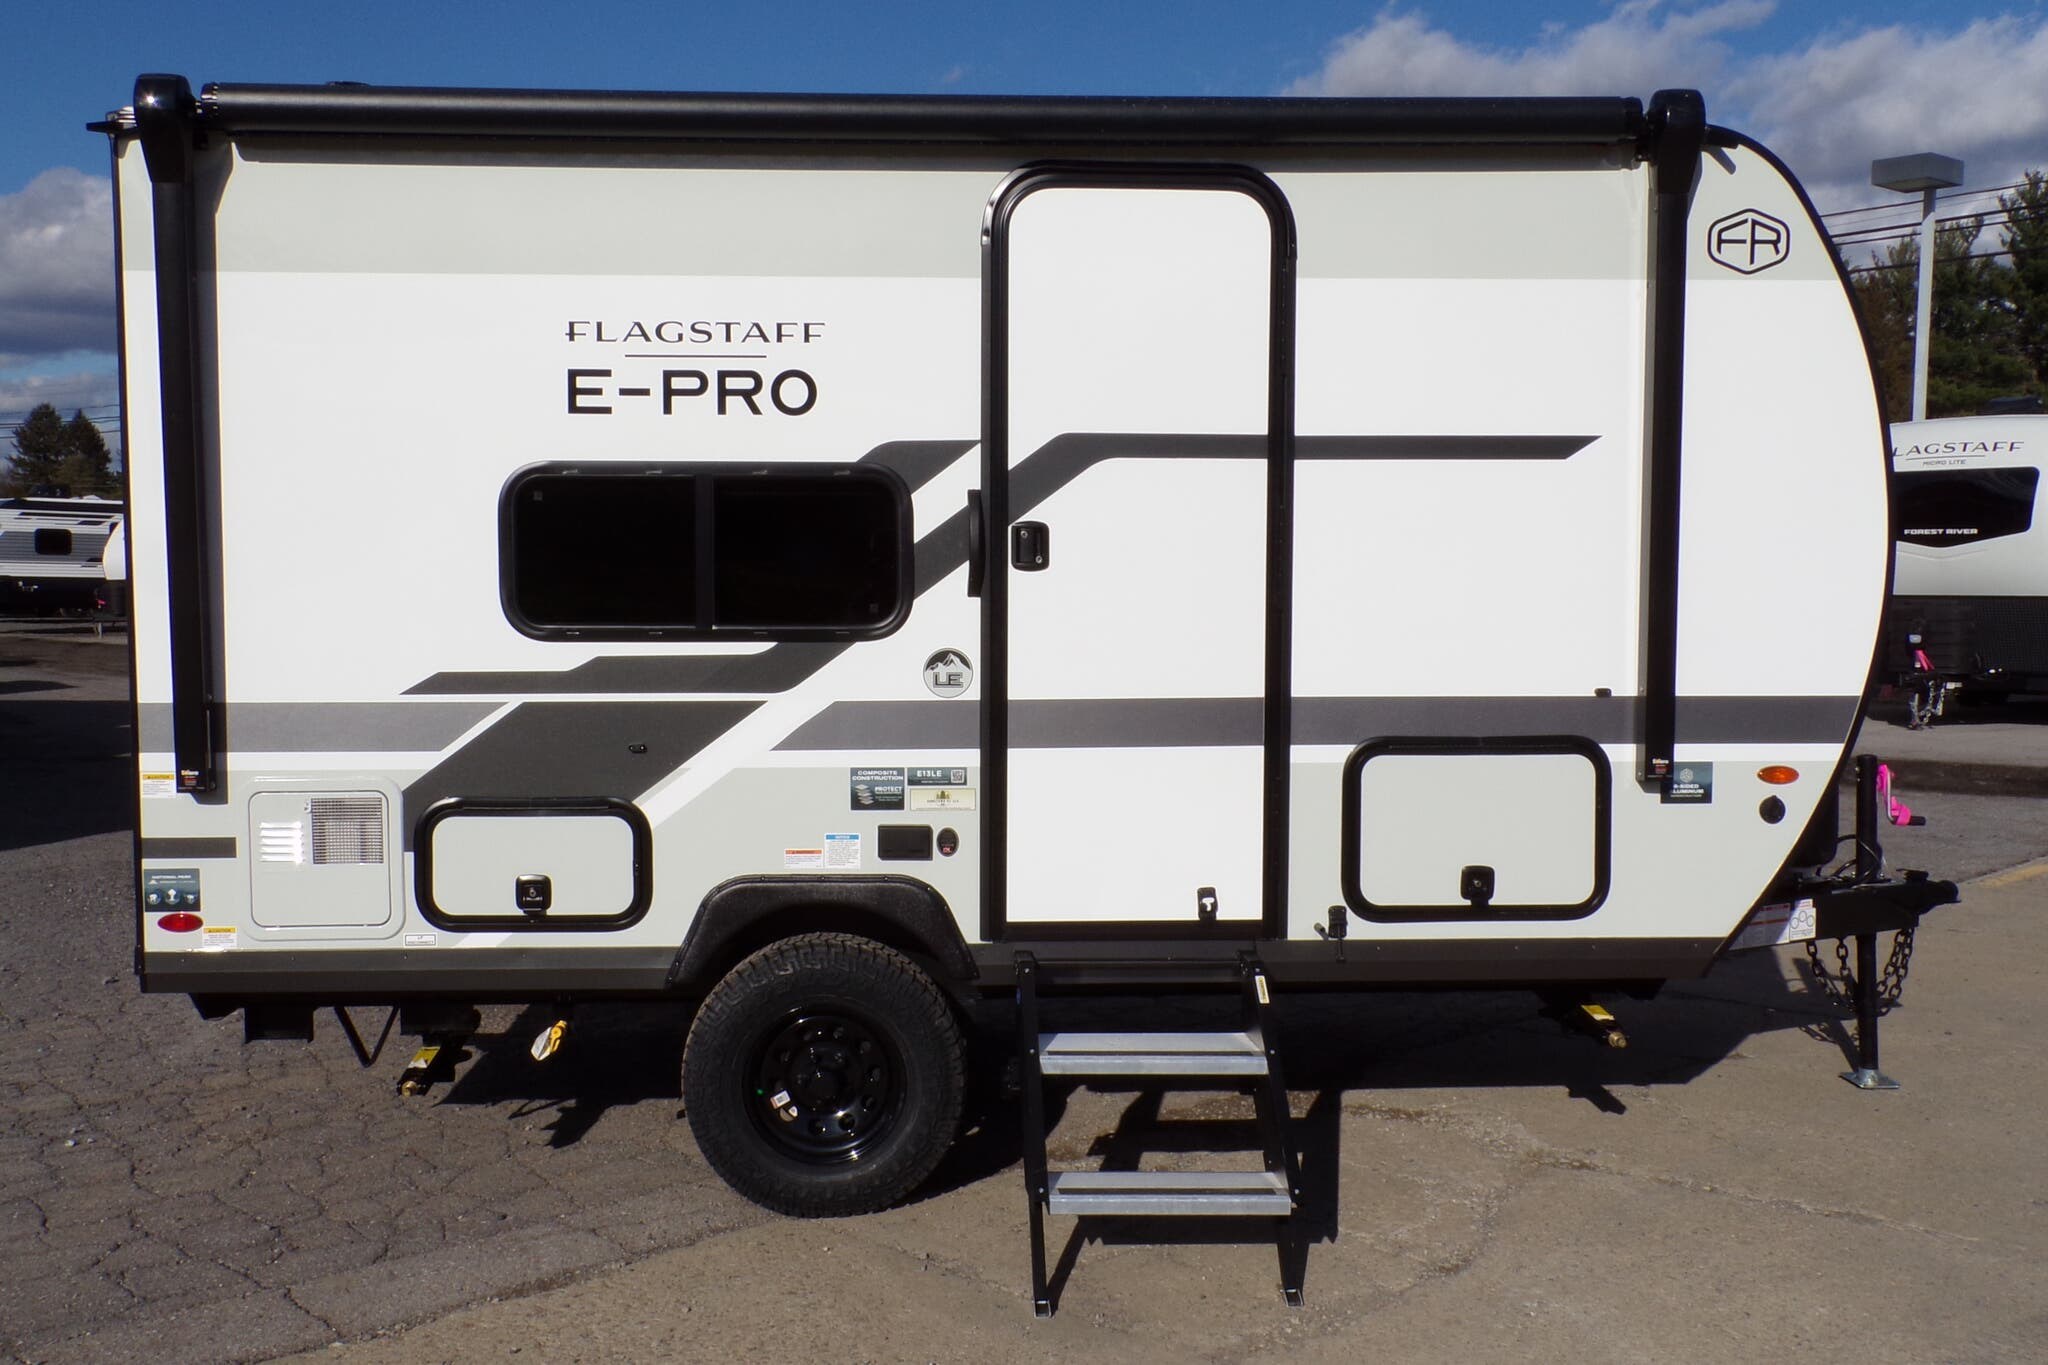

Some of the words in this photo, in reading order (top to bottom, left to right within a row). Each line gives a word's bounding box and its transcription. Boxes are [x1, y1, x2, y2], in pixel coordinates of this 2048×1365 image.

[565, 321, 826, 344] FLAGSTAFF
[567, 368, 818, 416] E-PRO
[1892, 441, 2025, 457] LAGSTAFF
[933, 672, 963, 688] LE
